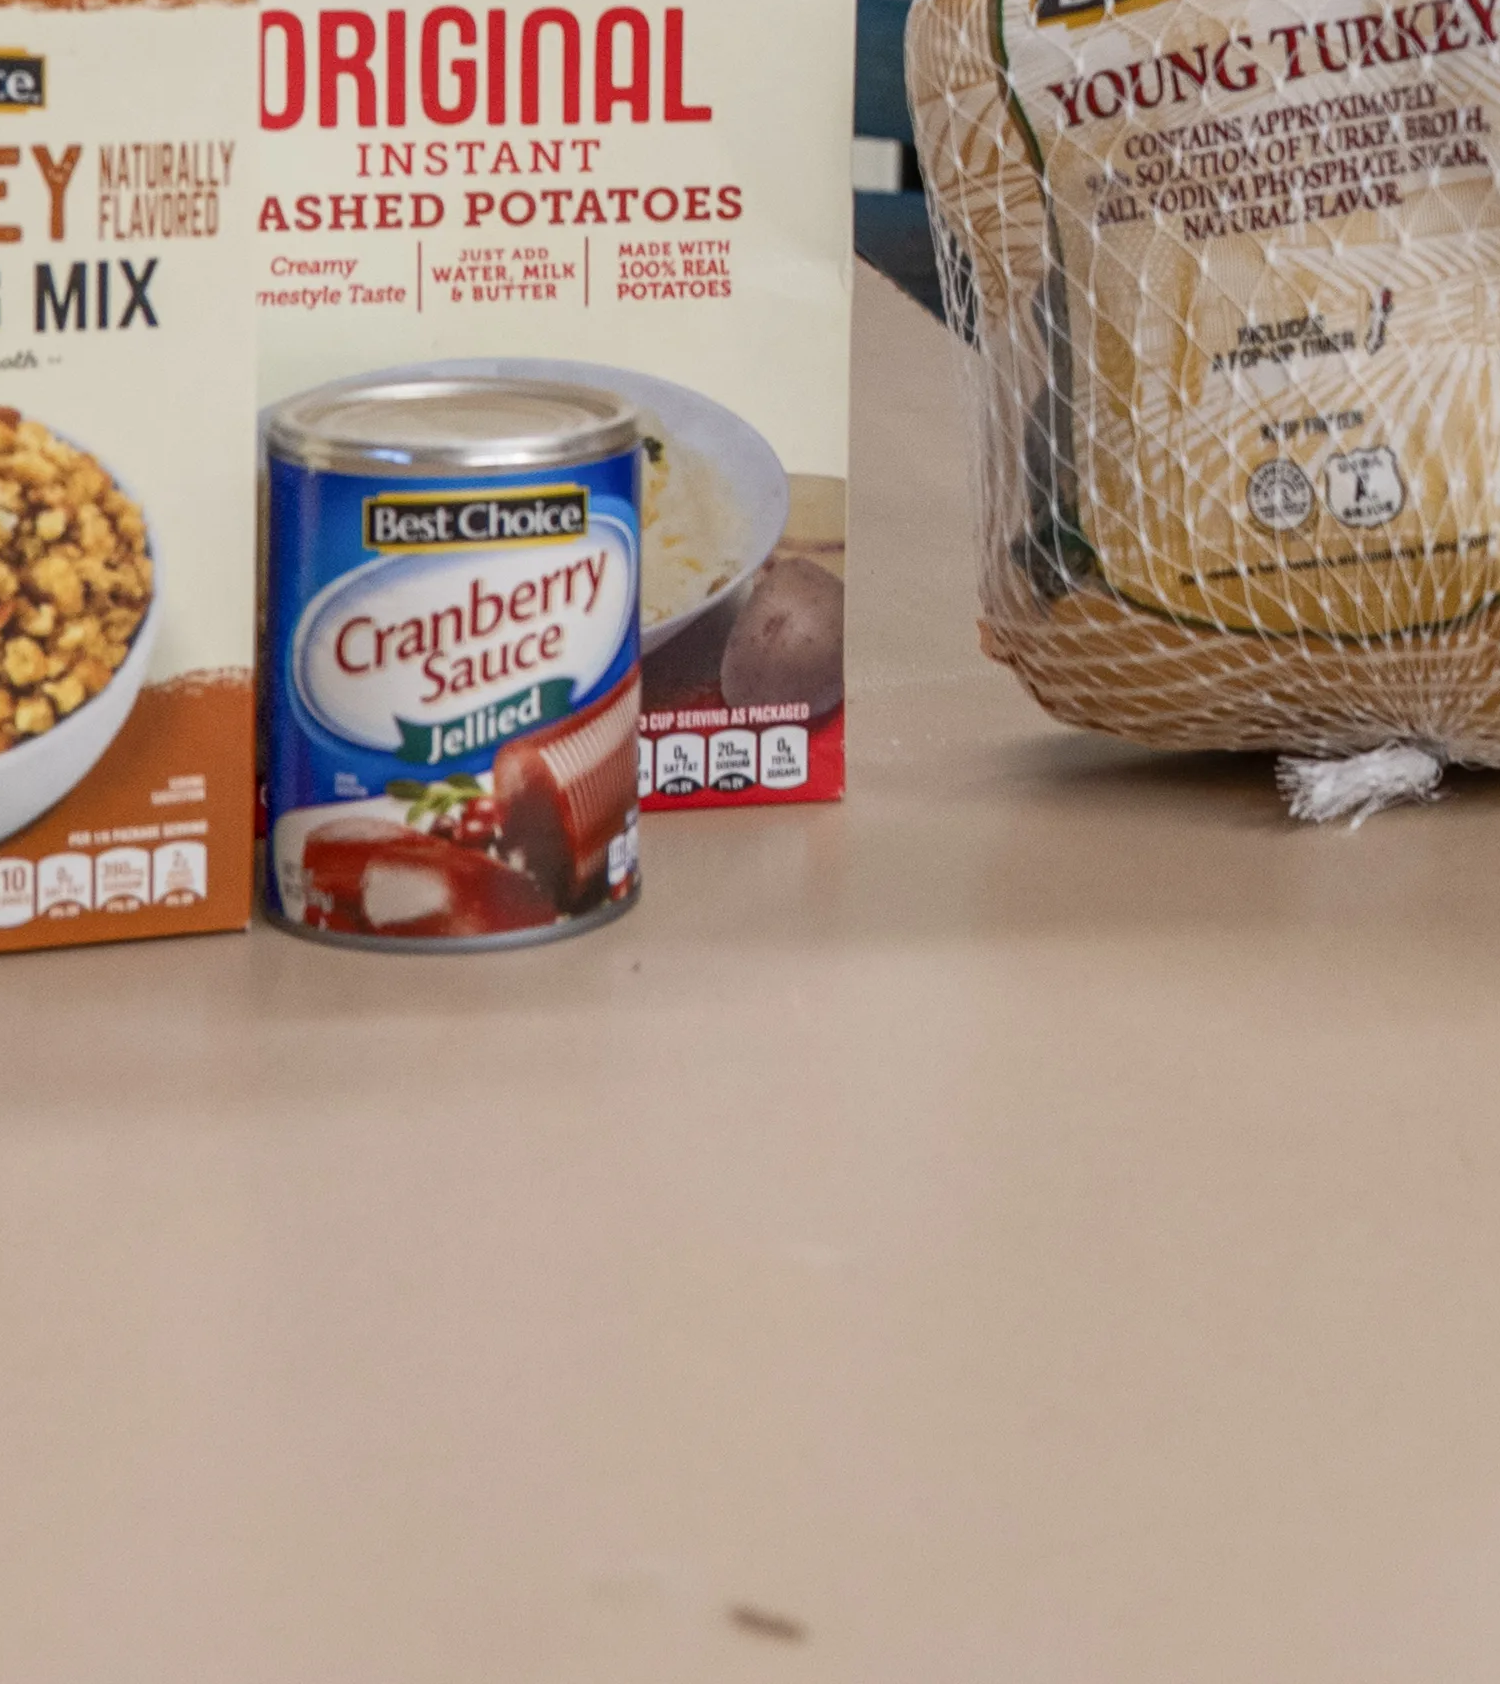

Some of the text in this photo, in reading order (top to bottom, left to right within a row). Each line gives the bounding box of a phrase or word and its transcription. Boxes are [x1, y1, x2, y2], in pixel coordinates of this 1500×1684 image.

[259, 5, 713, 131] ORIGINAL
[1048, 36, 1259, 127] YOUNG
[1123, 82, 1437, 161] CONTAINS APPROXIMATELY
[98, 140, 237, 190] NATURALLY
[356, 139, 602, 178] INSTANT
[1135, 145, 1258, 189] SOLUTION
[1266, 136, 1302, 165] OF
[97, 192, 220, 242] FLAVORED
[257, 185, 743, 232] ASHED POTATOES
[1182, 181, 1404, 242] NATURAL FLAVOR
[269, 256, 359, 279] Creamy
[458, 247, 550, 263] JUST ADD
[618, 240, 731, 258] MADE WITH
[618, 258, 730, 279] 100% REAL
[32, 256, 162, 334] MIX
[255, 283, 407, 310] mestyle Taste
[431, 262, 576, 284] WATER, MILK
[450, 283, 558, 303] & BUTTER
[616, 279, 733, 301] POTATOES
[373, 499, 582, 543] Best Choice
[333, 551, 609, 676] Cranberry
[419, 623, 563, 705] Sauce
[427, 686, 542, 764] Jellied
[649, 711, 675, 733] CUP
